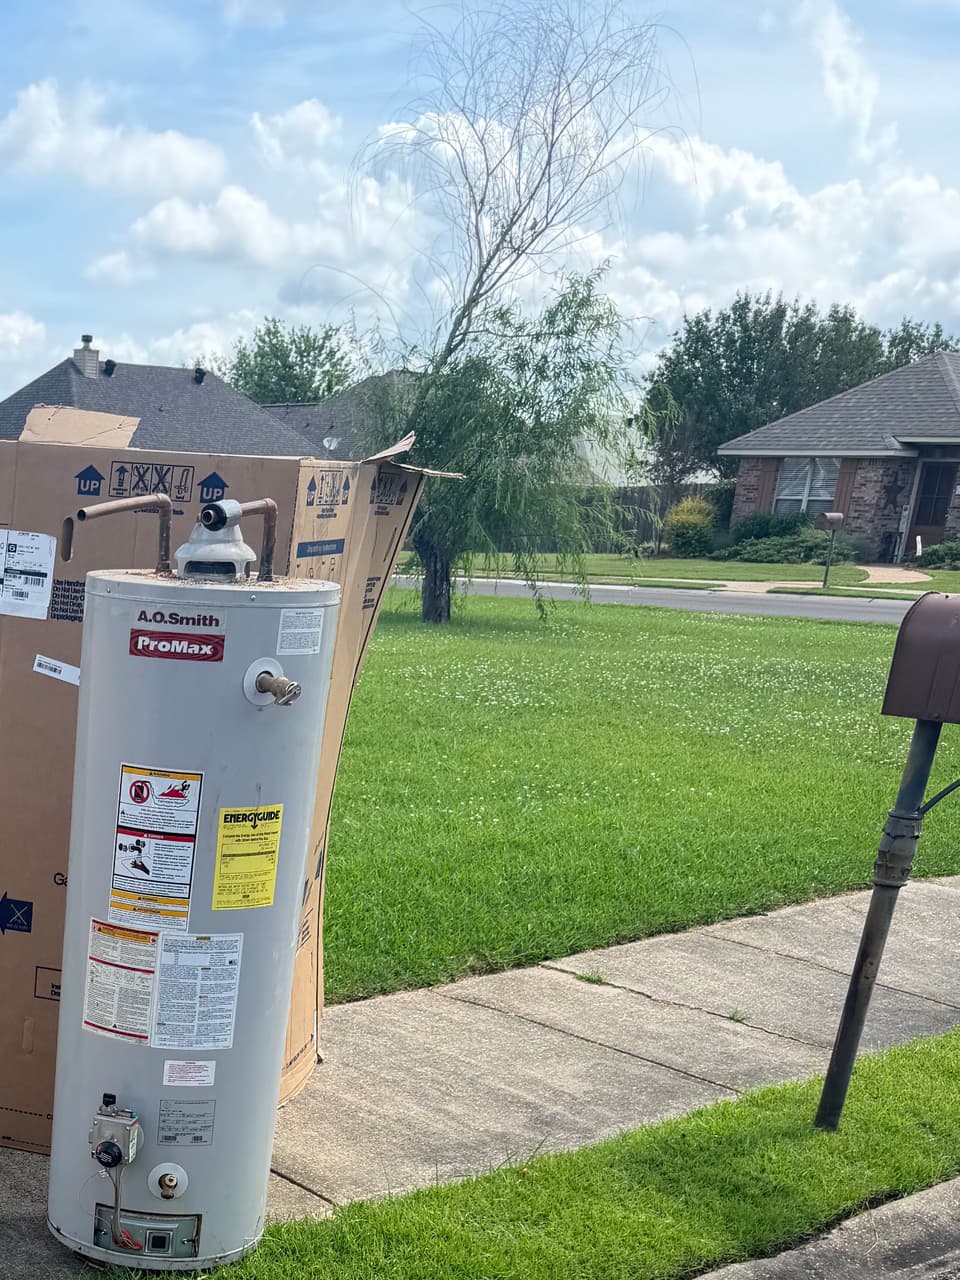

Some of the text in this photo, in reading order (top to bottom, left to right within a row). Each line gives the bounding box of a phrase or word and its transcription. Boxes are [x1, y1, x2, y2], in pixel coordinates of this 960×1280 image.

[80, 479, 99, 491] UP
[202, 489, 222, 500] UP
[137, 610, 220, 627] A.O.Smith
[137, 636, 214, 655] ProMax
